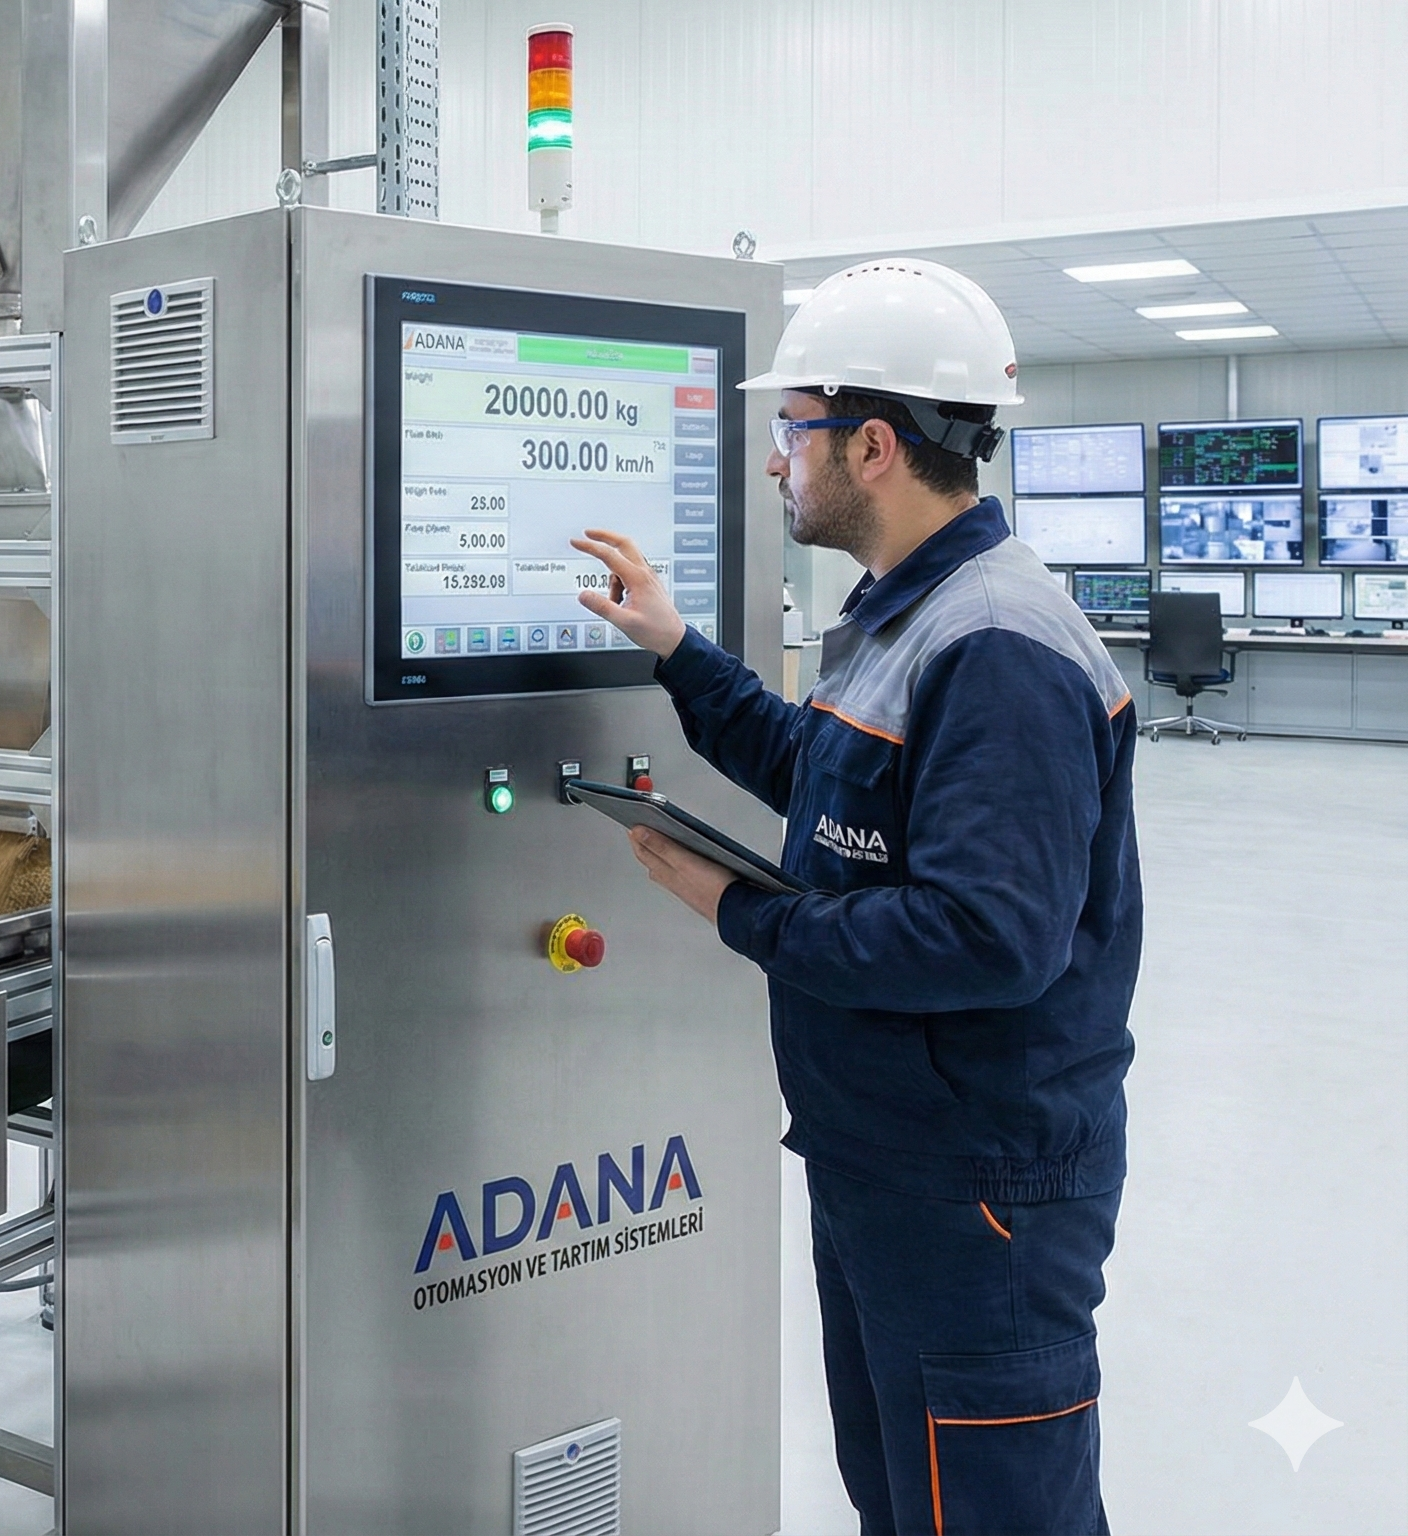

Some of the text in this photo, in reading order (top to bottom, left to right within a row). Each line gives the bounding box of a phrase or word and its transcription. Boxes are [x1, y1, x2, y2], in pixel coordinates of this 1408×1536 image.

[414, 332, 465, 351] ADANA
[484, 383, 638, 427] 20000.00 kg
[521, 438, 654, 473] 300.00 km/h
[815, 814, 887, 853] ADANA
[413, 1135, 702, 1275] ADANA
[413, 1206, 703, 1310] OTOMASYON VE TARTIM SİSTEMLERİ
